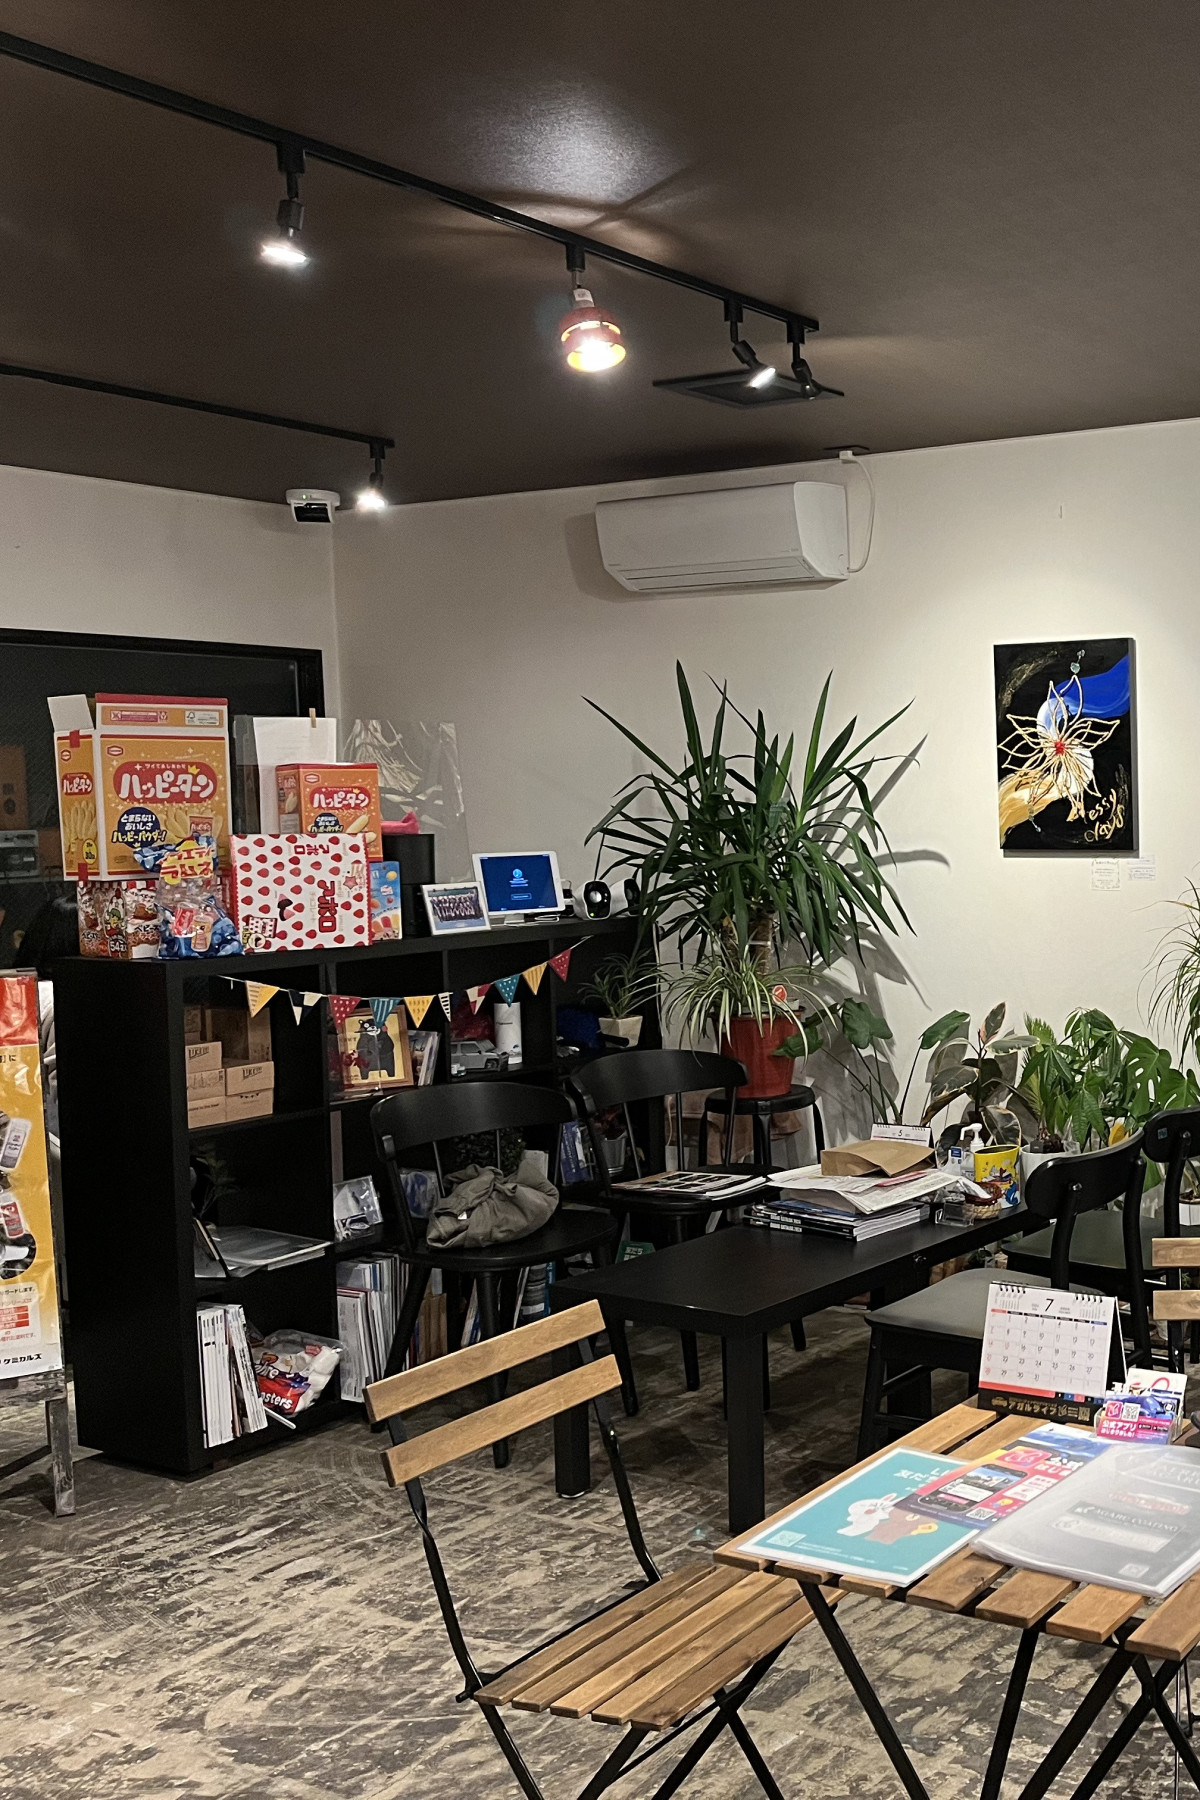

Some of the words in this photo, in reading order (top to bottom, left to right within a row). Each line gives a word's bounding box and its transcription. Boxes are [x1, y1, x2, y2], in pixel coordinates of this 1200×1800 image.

[62, 776, 93, 794] ハッピーターン
[118, 770, 214, 800] ハッピーターン
[313, 791, 370, 808] ハッピーターン
[121, 813, 156, 822] とまらない
[125, 822, 154, 831] おいしさ
[294, 844, 330, 856] アポロ
[317, 880, 338, 933] アポロ
[898, 1129, 903, 1137] 5
[1045, 1298, 1055, 1312] 7
[1019, 1357, 1025, 1365] 23
[1052, 1362, 1058, 1370] 25
[1069, 1364, 1075, 1372] 26
[1086, 1366, 1093, 1374] 27
[1001, 1369, 1007, 1377] 29
[1009, 1401, 1057, 1415] アガルライフ
[1102, 1420, 1137, 1432] 公式アプリ
